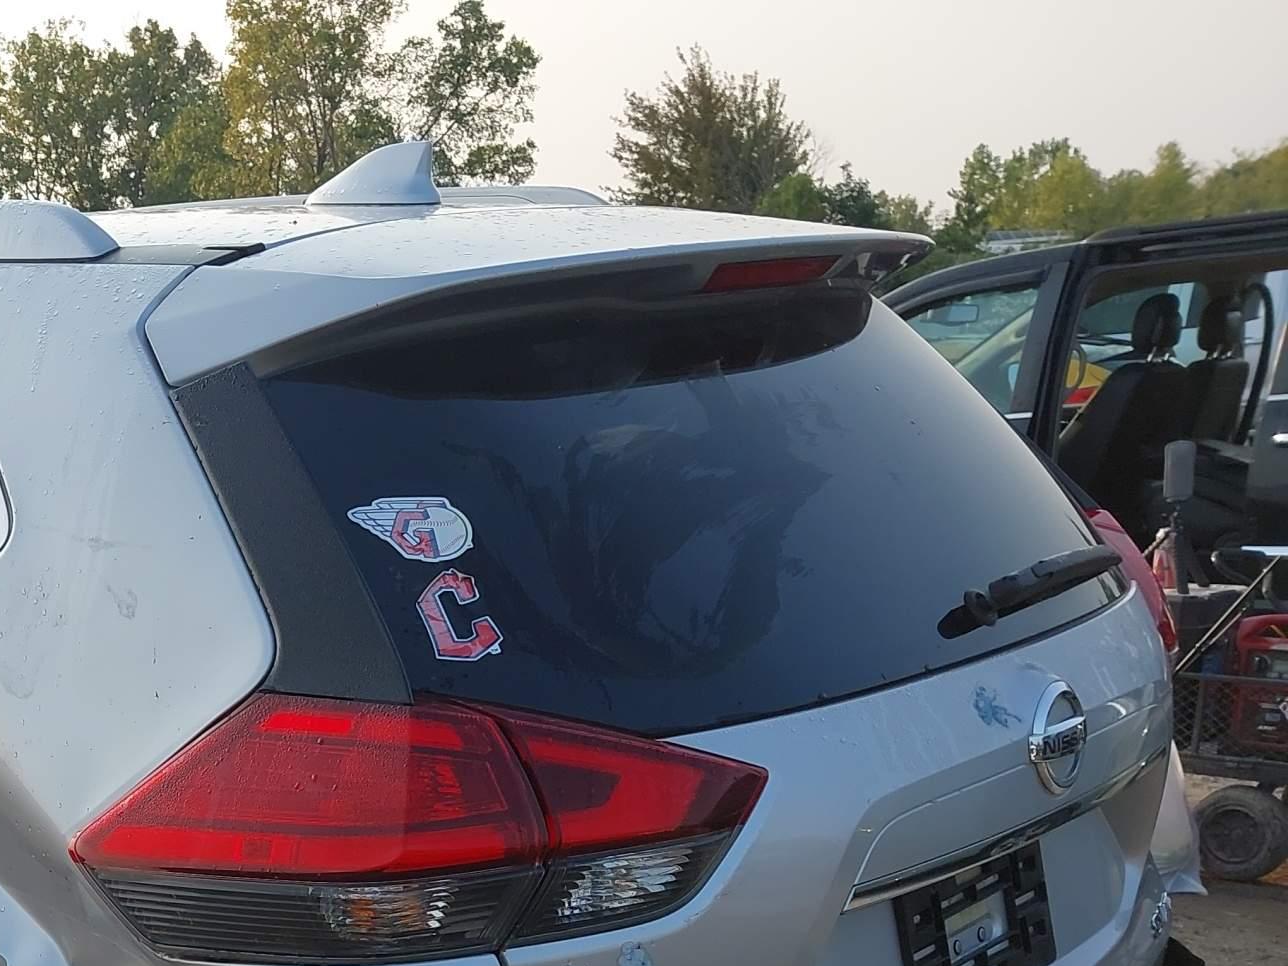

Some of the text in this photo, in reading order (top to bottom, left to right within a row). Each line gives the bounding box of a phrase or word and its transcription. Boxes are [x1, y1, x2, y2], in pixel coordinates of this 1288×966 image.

[392, 509, 441, 559] G
[416, 568, 503, 661] C
[1042, 724, 1086, 757] NISS
